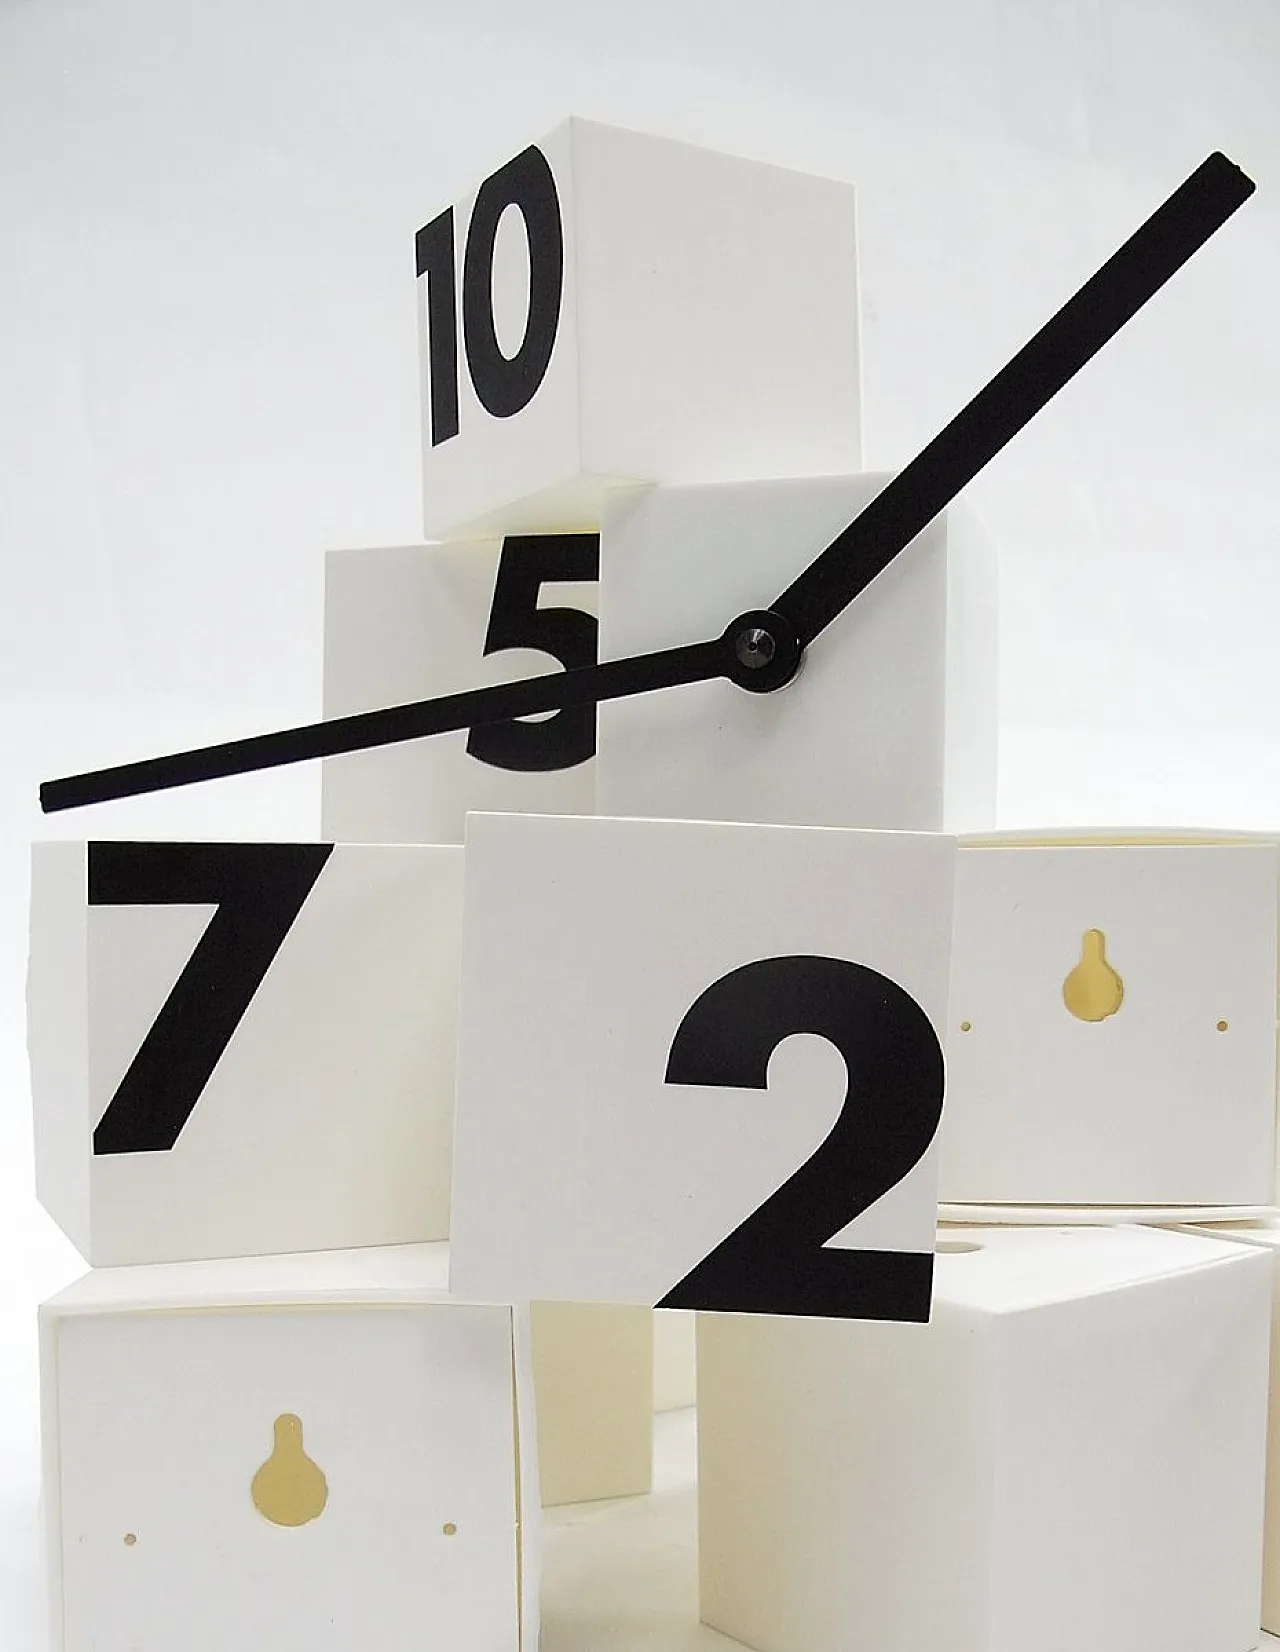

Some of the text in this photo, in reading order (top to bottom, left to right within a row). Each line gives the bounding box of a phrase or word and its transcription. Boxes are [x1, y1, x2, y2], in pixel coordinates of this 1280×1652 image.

[415, 144, 564, 447] 10
[466, 533, 600, 772] 5
[87, 840, 335, 1156] 7
[653, 954, 945, 1323] 2
